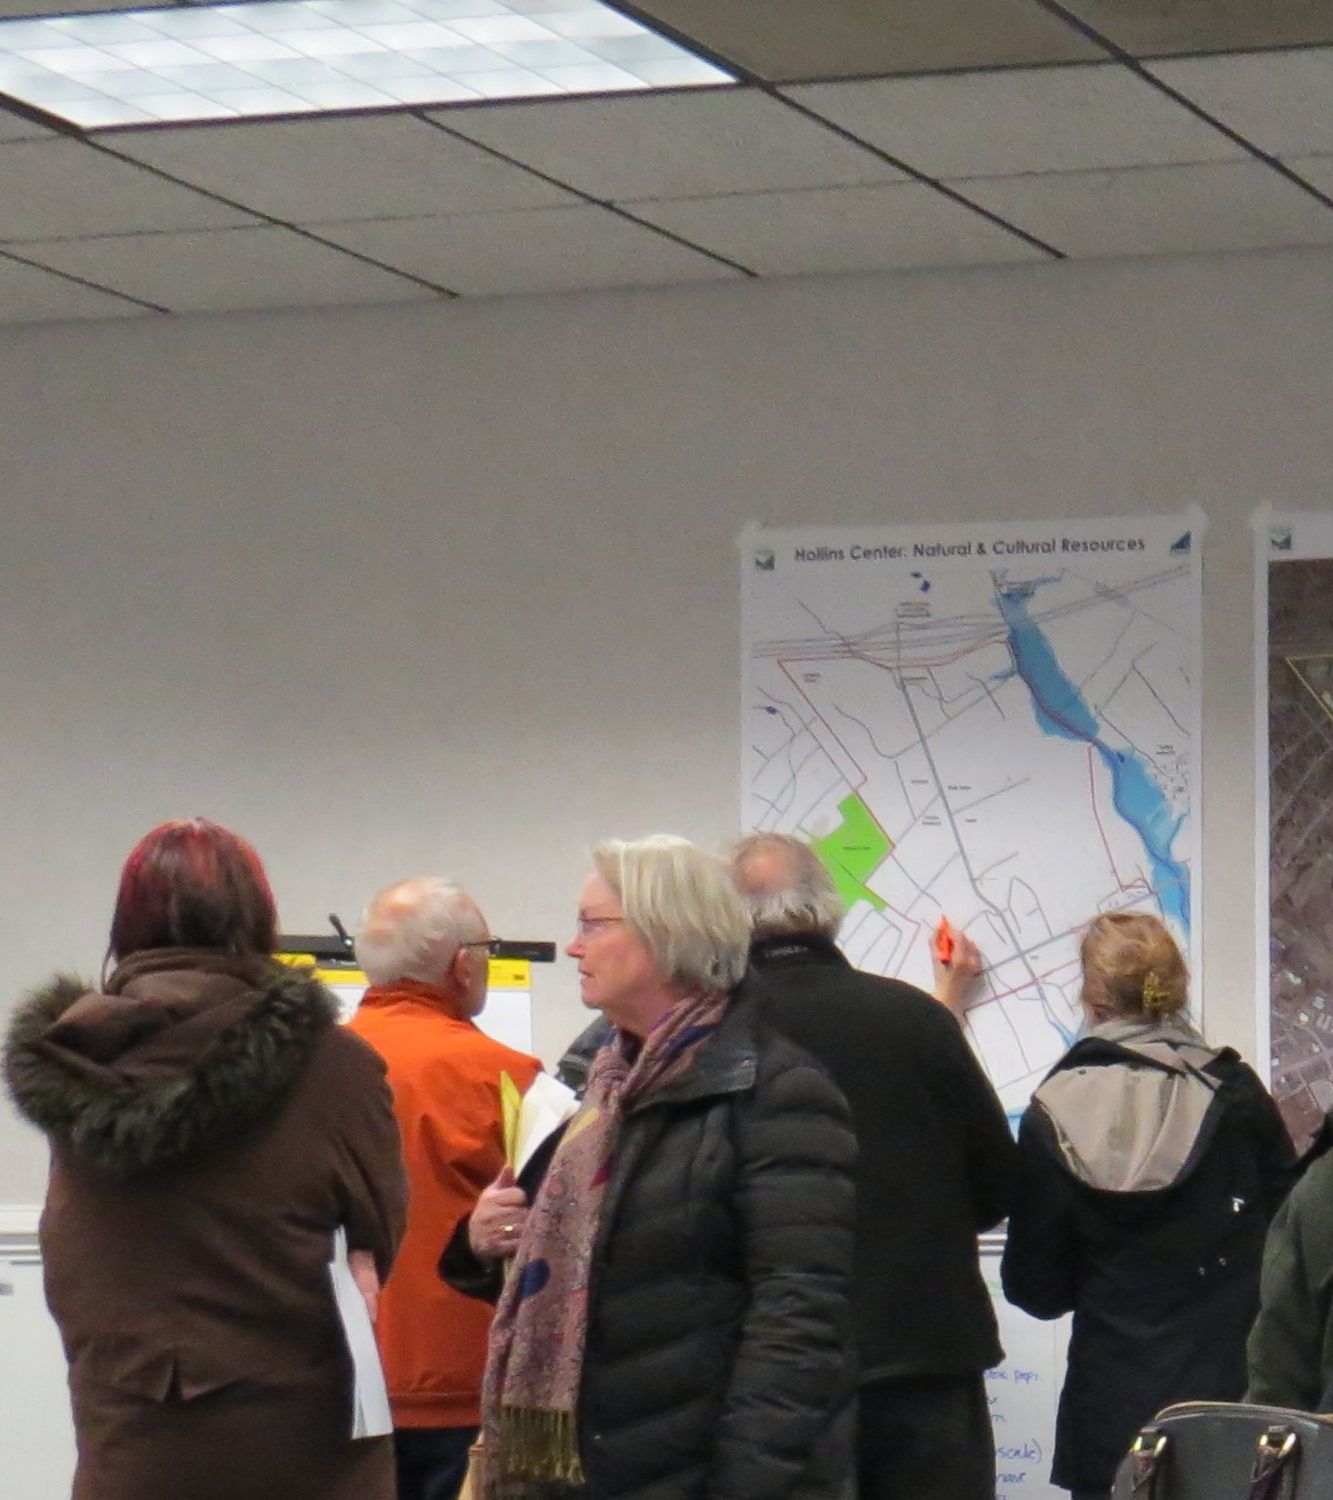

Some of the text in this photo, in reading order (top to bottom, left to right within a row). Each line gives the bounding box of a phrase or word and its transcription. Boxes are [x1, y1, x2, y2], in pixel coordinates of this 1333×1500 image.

[795, 547, 845, 563] Hollins
[913, 542, 972, 558] Natural
[977, 543, 988, 556] &
[993, 538, 1056, 556] Cultural
[1061, 537, 1145, 554] Resources
